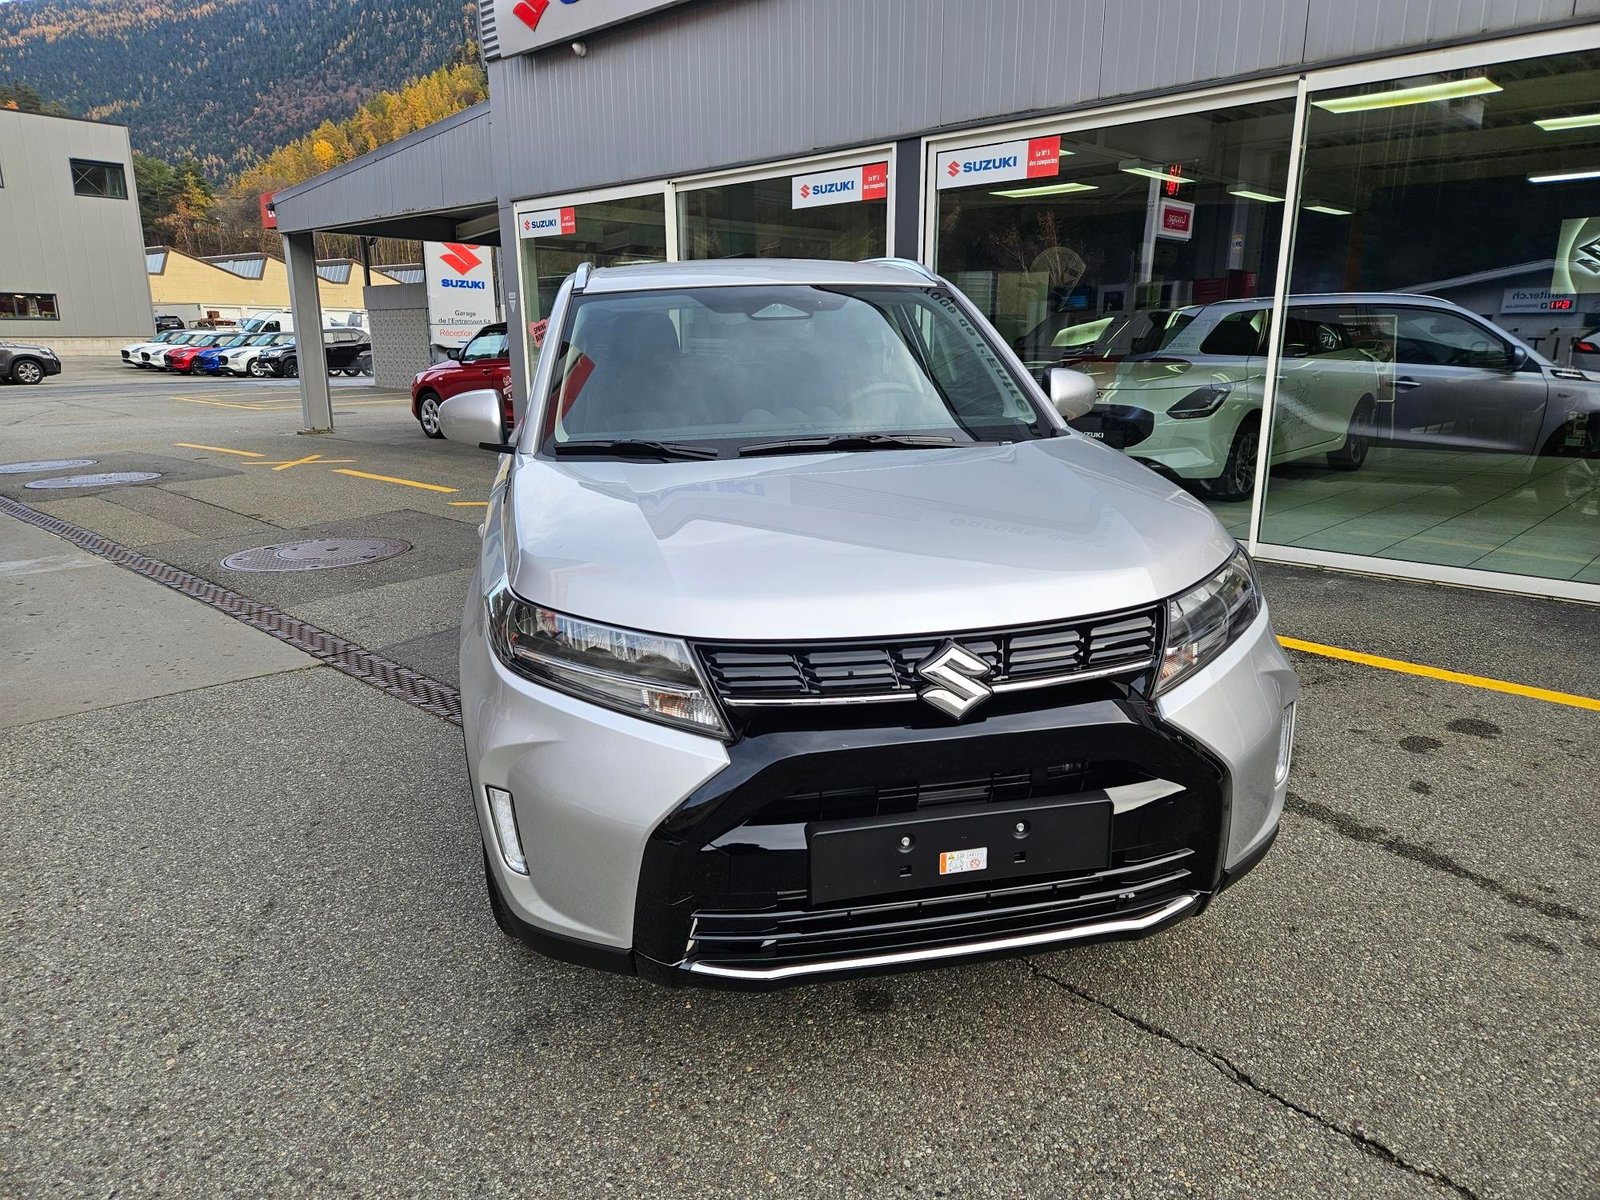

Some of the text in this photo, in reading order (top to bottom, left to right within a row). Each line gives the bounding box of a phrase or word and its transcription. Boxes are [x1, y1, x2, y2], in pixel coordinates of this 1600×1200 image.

[963, 155, 1017, 173] SUZUKI
[812, 180, 855, 195] SUZUKI
[531, 219, 557, 229] SUZUKI
[441, 279, 485, 290] SUZUKI
[454, 309, 477, 318] Garage
[440, 328, 473, 338] Réception
